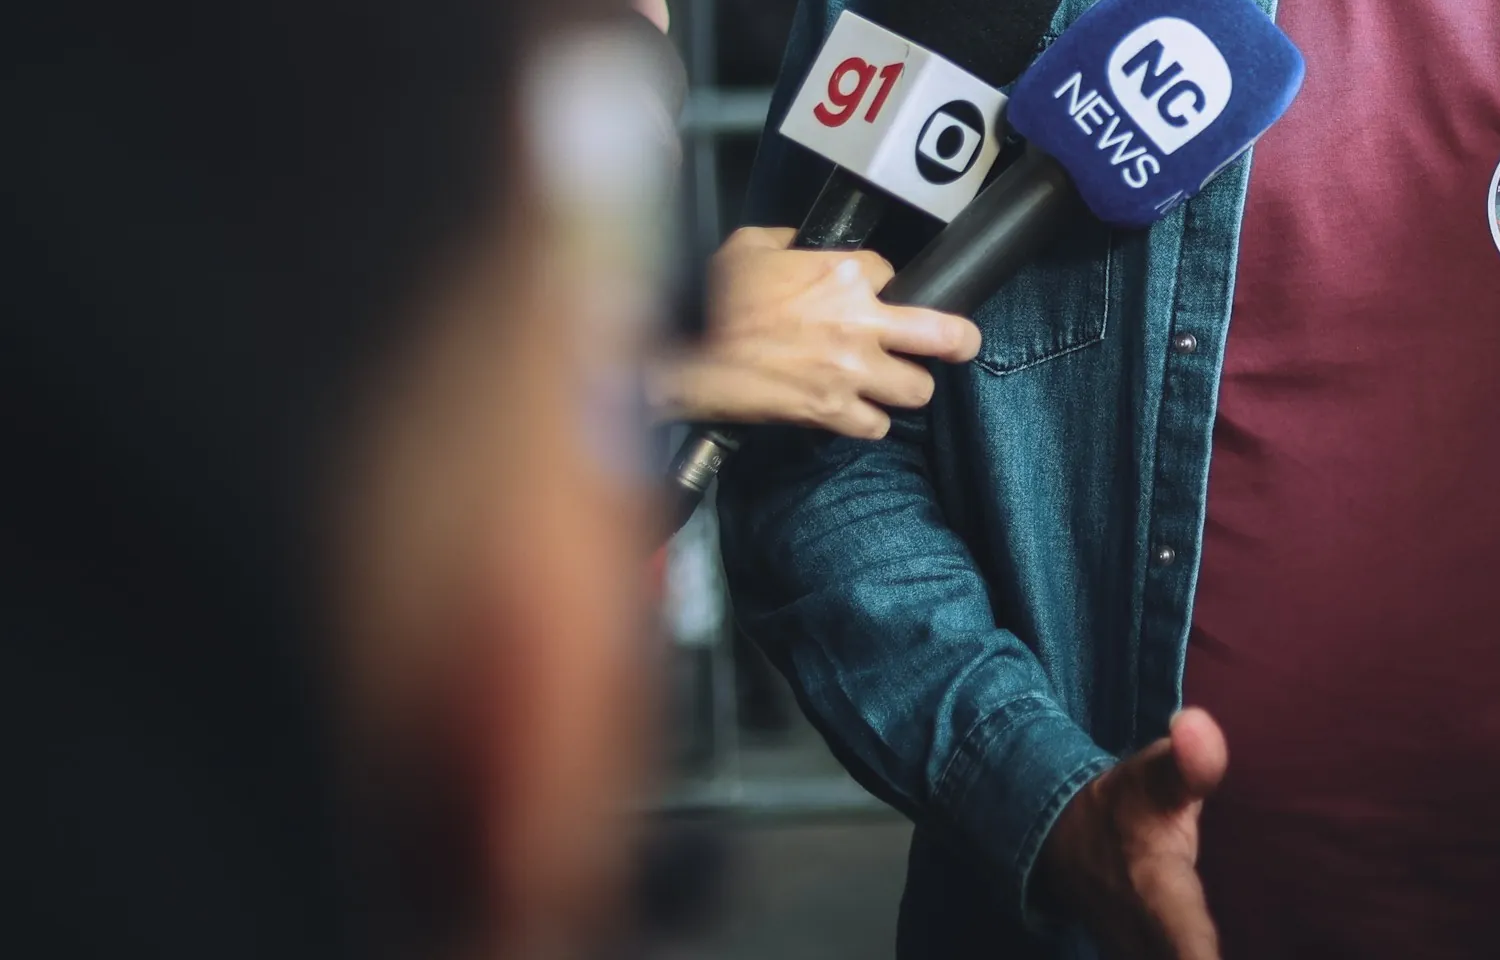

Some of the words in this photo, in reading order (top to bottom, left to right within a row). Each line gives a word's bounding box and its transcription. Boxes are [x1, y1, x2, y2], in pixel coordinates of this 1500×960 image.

[812, 56, 904, 128] g1
[1053, 71, 1161, 189] NEWS
[1120, 38, 1208, 130] NC
